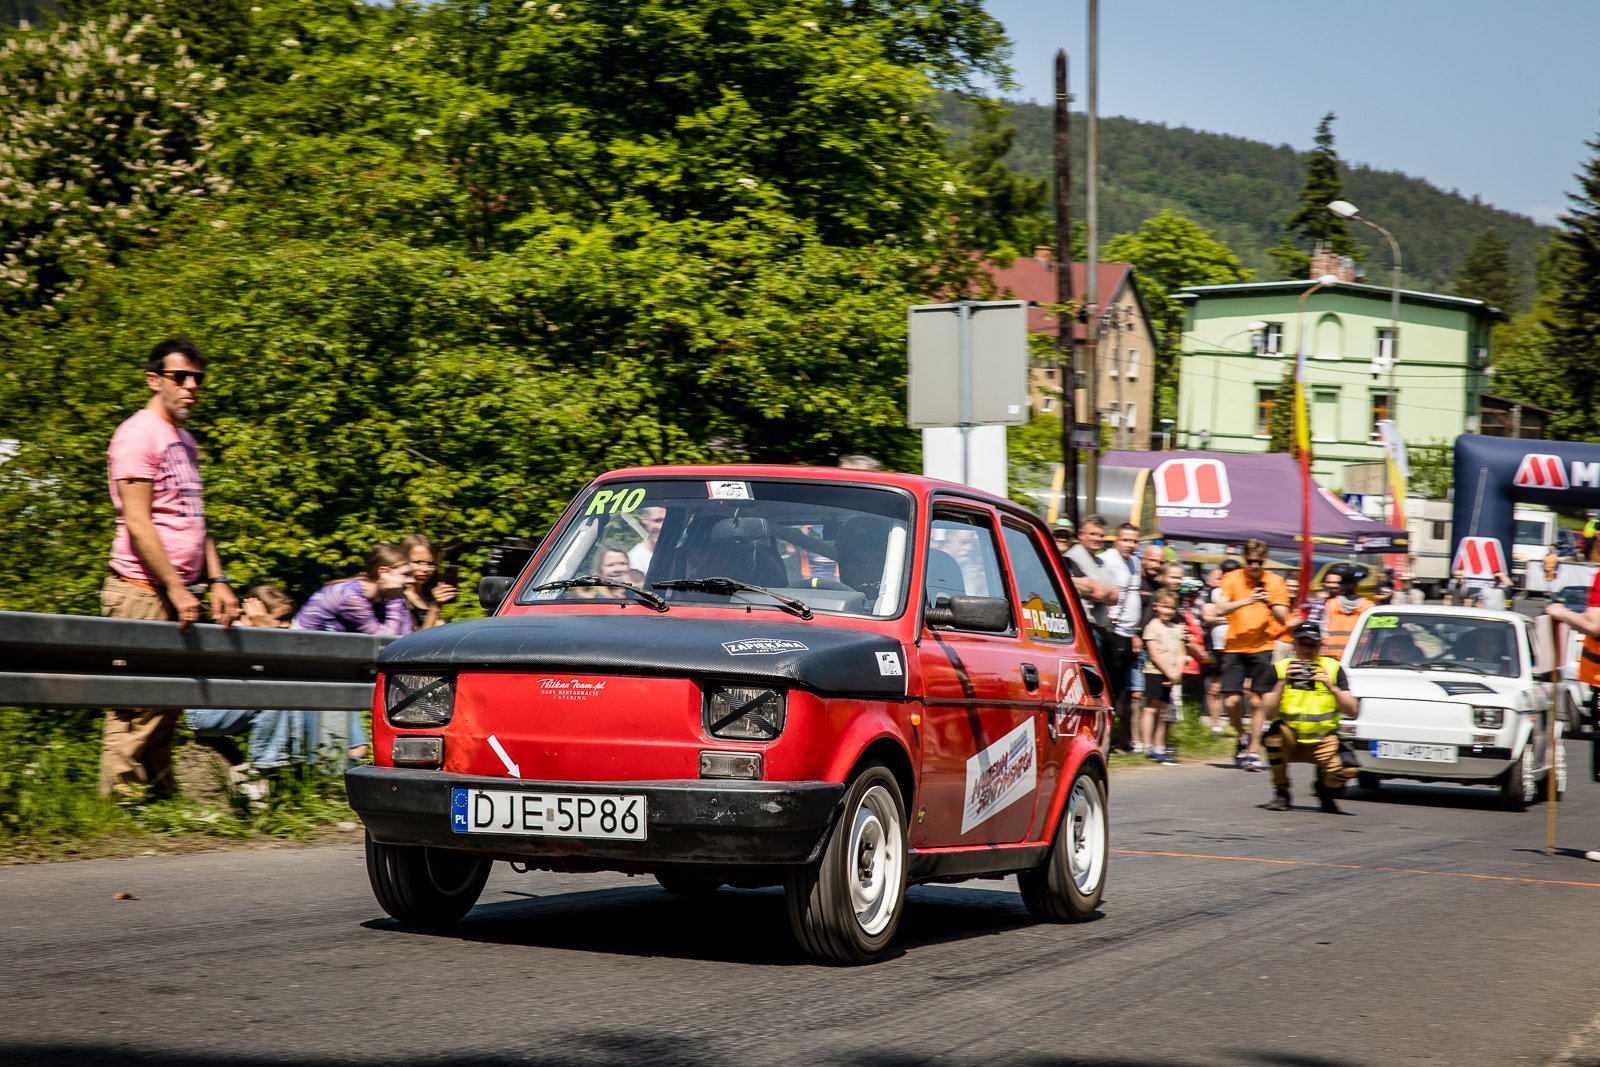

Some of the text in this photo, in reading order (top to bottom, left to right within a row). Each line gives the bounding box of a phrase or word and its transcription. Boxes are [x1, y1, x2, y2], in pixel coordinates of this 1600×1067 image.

[585, 487, 646, 516] R10
[536, 678, 607, 691] Pelikan Team.pl
[455, 815, 467, 825] PL
[474, 793, 638, 834] DJE 5P86
